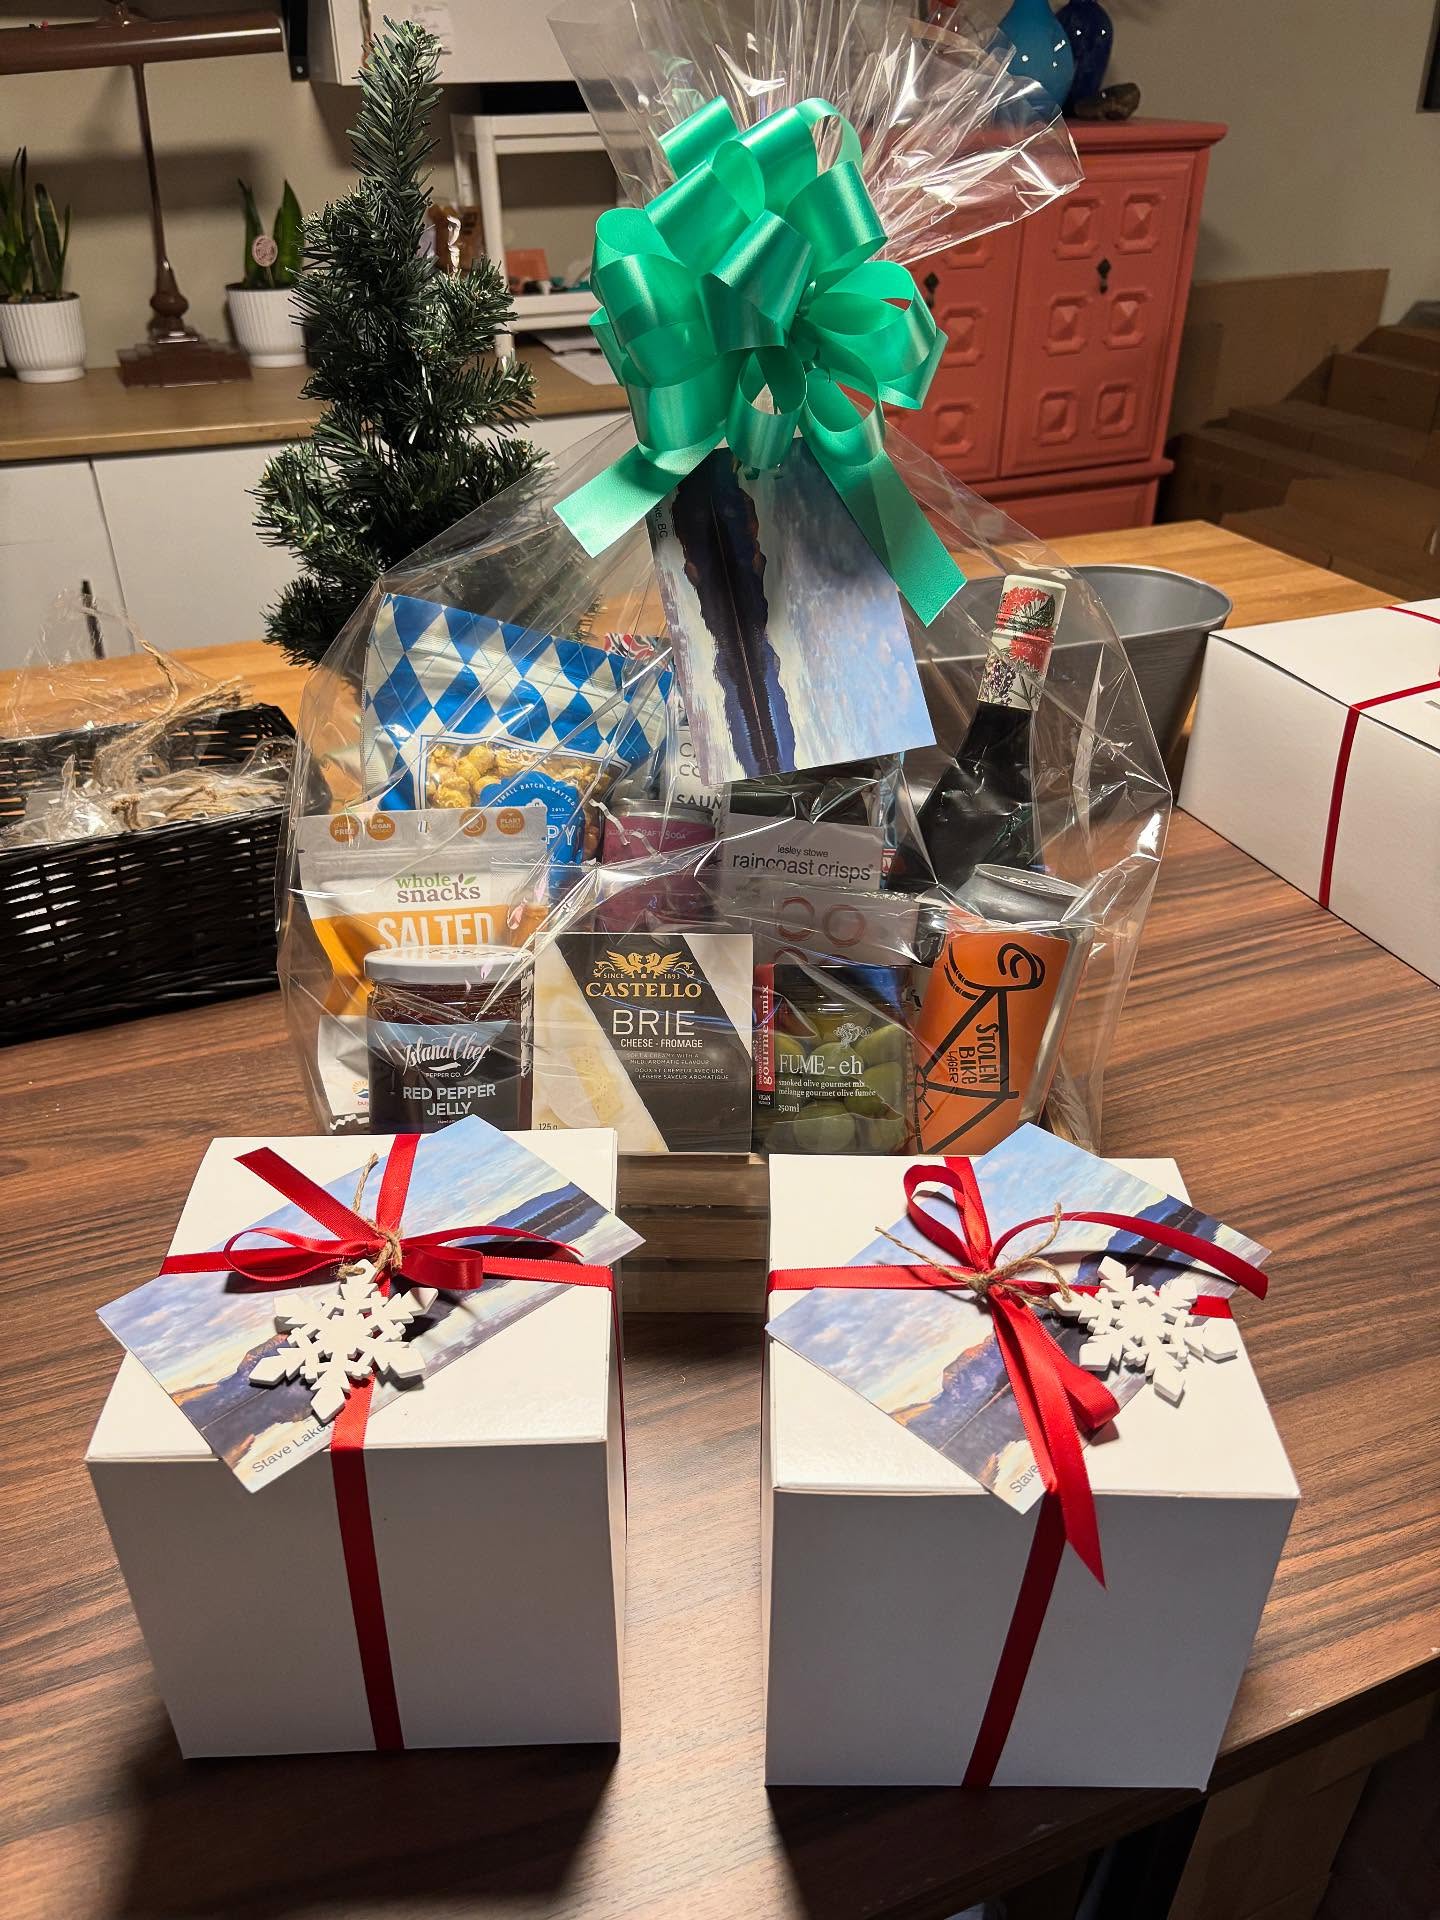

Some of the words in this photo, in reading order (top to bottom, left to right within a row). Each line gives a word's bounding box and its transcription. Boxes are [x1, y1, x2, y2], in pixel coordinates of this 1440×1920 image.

[658, 523, 669, 538] BC
[496, 787, 518, 805] SMALL
[547, 786, 575, 806] CRAFTED
[335, 828, 355, 836] FREE
[665, 830, 688, 840] SODA
[777, 844, 802, 857] lesley
[803, 847, 829, 858] stowe
[732, 852, 815, 876] raincoast
[395, 872, 450, 888] whole
[396, 882, 482, 904] snacks
[377, 912, 496, 950] SALTED
[585, 982, 702, 998] CASTELLO
[761, 985, 770, 1016] mix
[612, 1009, 696, 1036] BRIE
[620, 1038, 654, 1048] CHEESE
[660, 1039, 703, 1048] FROMAGE
[762, 1018, 773, 1086] gourmet
[976, 1022, 1000, 1084] STOLEN
[779, 1054, 826, 1075] FUME
[839, 1055, 863, 1075] eh
[946, 1050, 959, 1084] LAGER
[403, 1086, 433, 1100] RED
[437, 1083, 497, 1100] PEPPER
[778, 1079, 802, 1087] smoked
[820, 1080, 851, 1090] gourmet
[805, 1089, 836, 1098] gourmet
[837, 1089, 854, 1097] olive
[426, 1101, 473, 1116] JELLY
[778, 1103, 800, 1113] 250ml
[252, 1445, 292, 1473] Stave
[292, 1423, 332, 1448] Lake,
[1009, 1464, 1039, 1493] Stave
